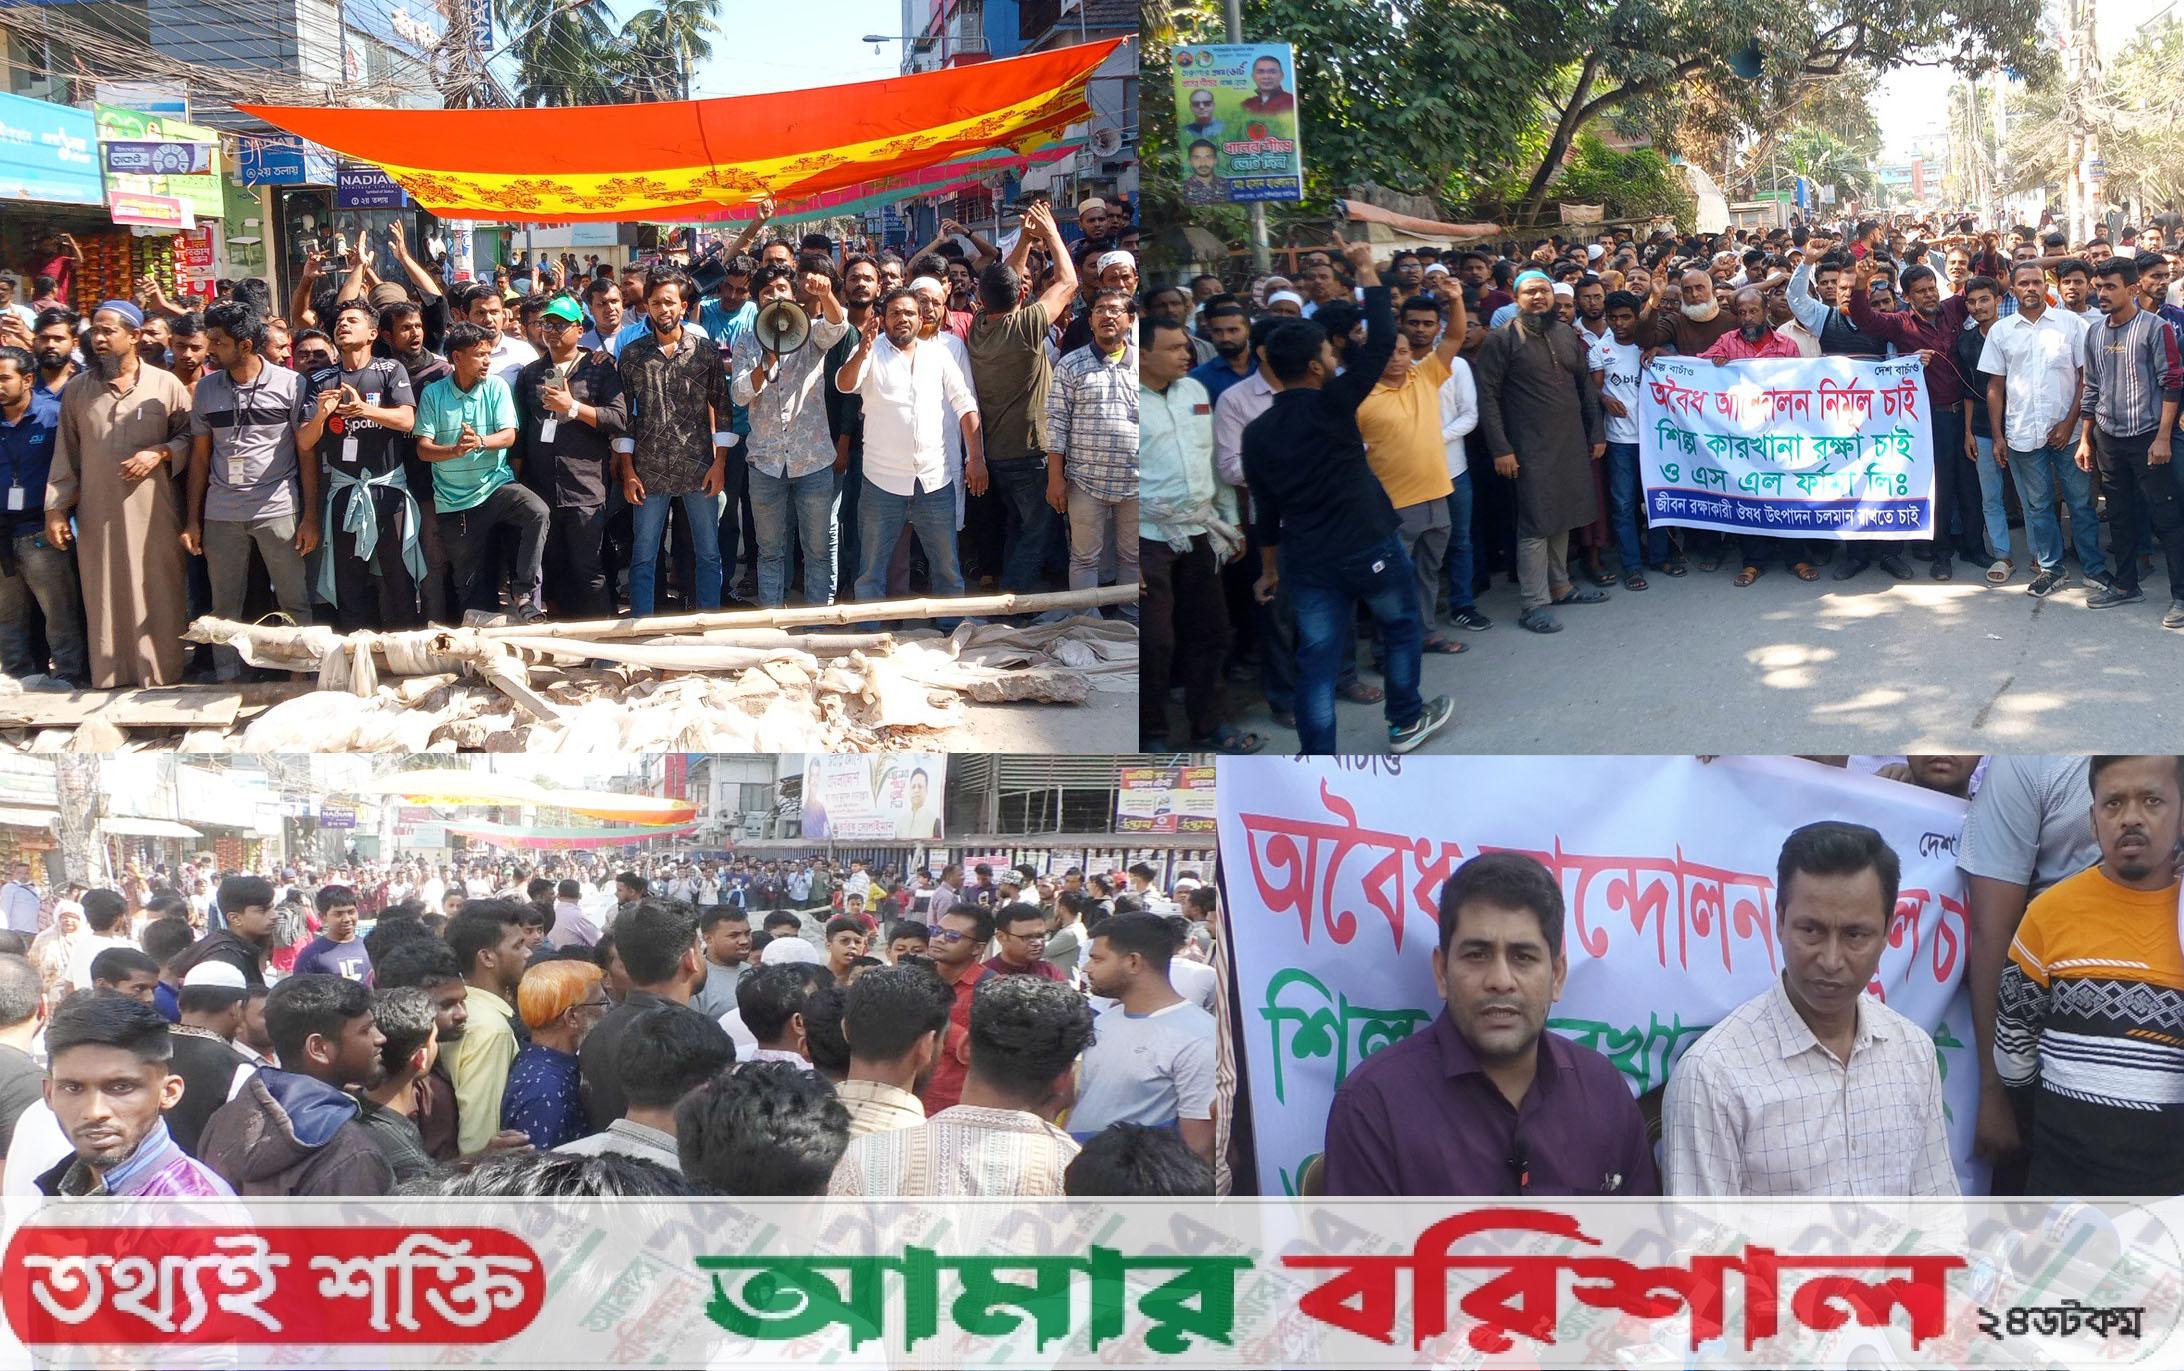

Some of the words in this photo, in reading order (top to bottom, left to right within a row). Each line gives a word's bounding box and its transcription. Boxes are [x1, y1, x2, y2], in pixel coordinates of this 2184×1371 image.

[273, 165, 299, 176] তলায়
[340, 175, 388, 186] NADIA
[1875, 366, 1892, 376] দেশ
[1649, 375, 1708, 420] অবৈধ
[1880, 376, 1919, 423] চাই
[1655, 418, 1698, 456] শিল্প
[1703, 433, 1804, 462] কারখানা
[1811, 430, 1864, 460] রক্ষা
[1871, 426, 1916, 463] চাই
[1659, 463, 1680, 483] ও
[1691, 467, 1728, 492] এস
[1738, 471, 1784, 496] এল
[1655, 490, 1688, 513] জীবন
[1689, 498, 1733, 520] রক্ষাকারী
[1736, 502, 1762, 523] ঔষধ
[1764, 504, 1811, 526] উৎপাদন
[1814, 508, 1855, 527] চলমান
[1897, 504, 1920, 528] চাই
[1239, 776, 1463, 955] অবৈধ
[1477, 834, 1778, 975] ন্দোলন
